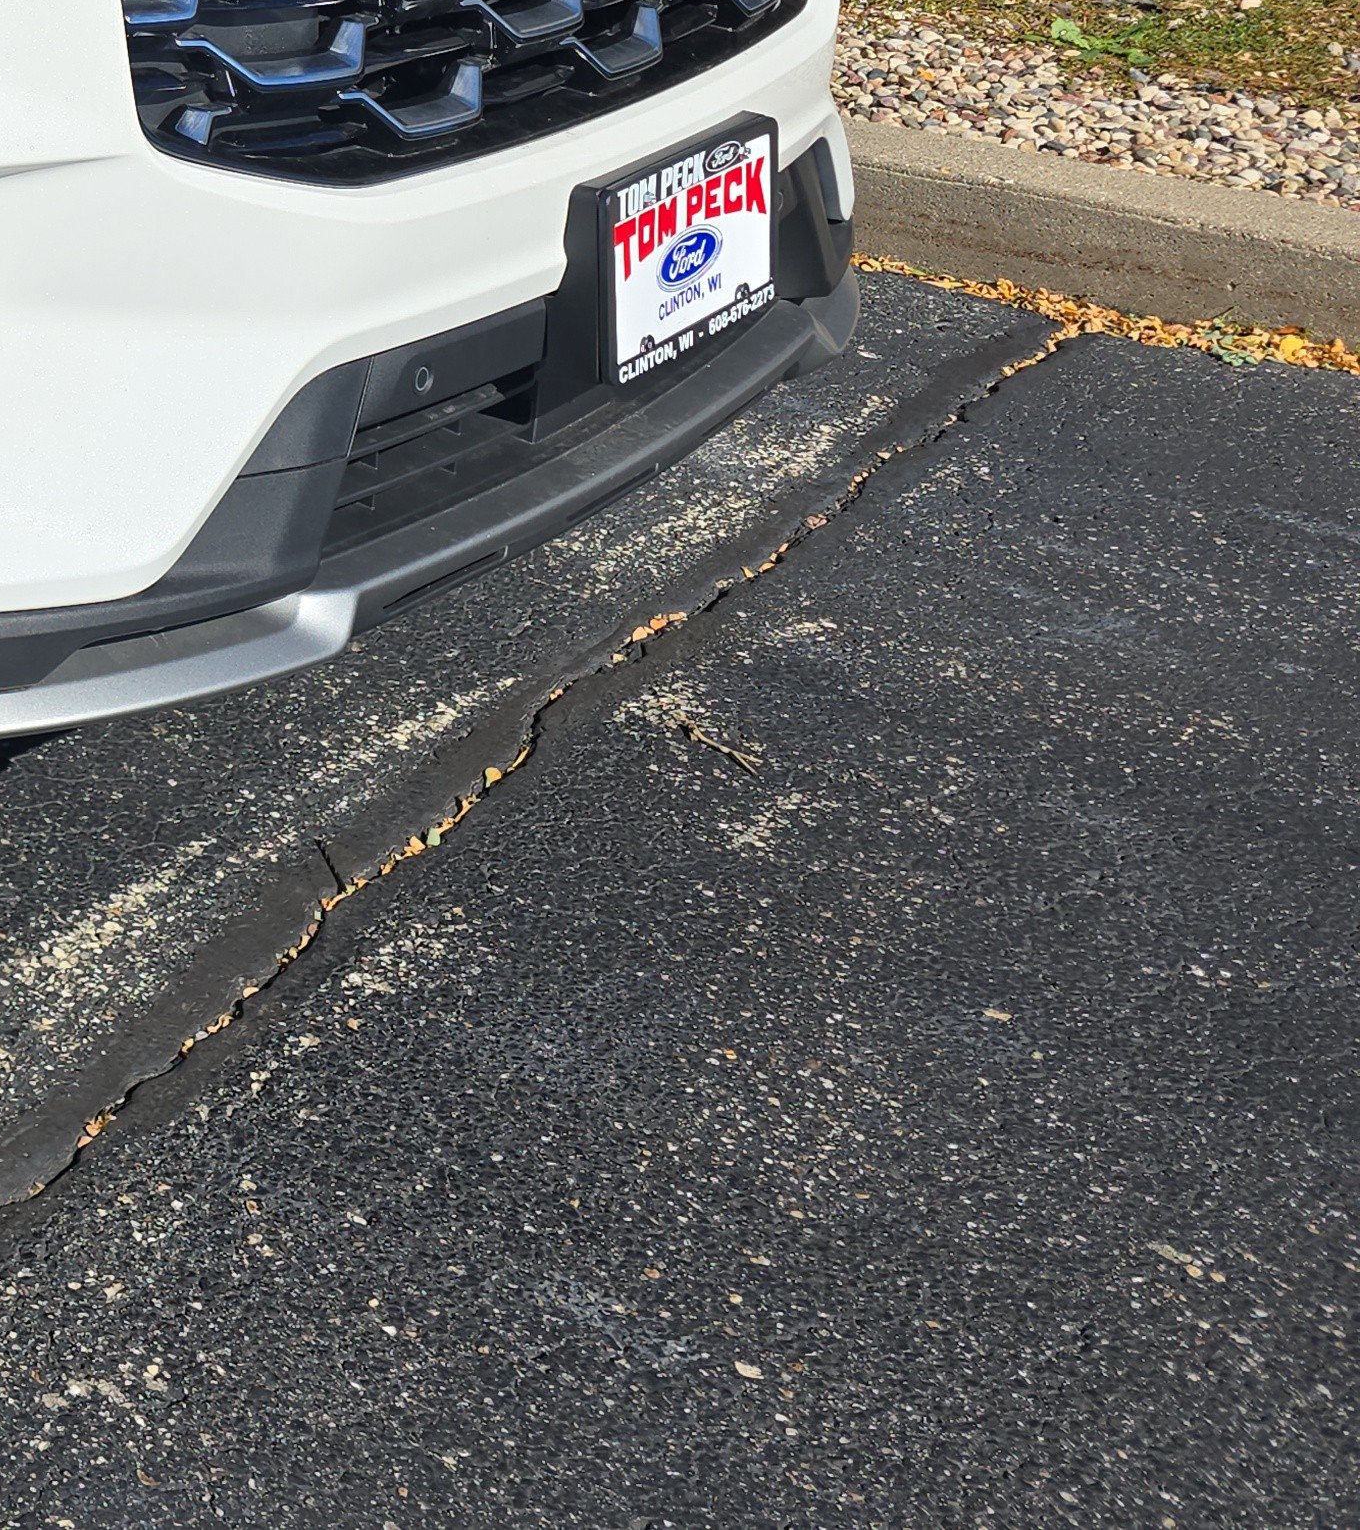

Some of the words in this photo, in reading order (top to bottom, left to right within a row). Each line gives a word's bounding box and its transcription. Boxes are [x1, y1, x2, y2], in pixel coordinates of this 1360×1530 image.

[617, 172, 658, 221] TOM
[661, 150, 707, 203] PECK
[613, 196, 678, 282] TOM
[686, 155, 767, 228] PECK
[658, 281, 705, 321] CLINTON,
[707, 273, 722, 293] WI
[618, 341, 678, 385] CLINTON,
[678, 330, 694, 353] WI
